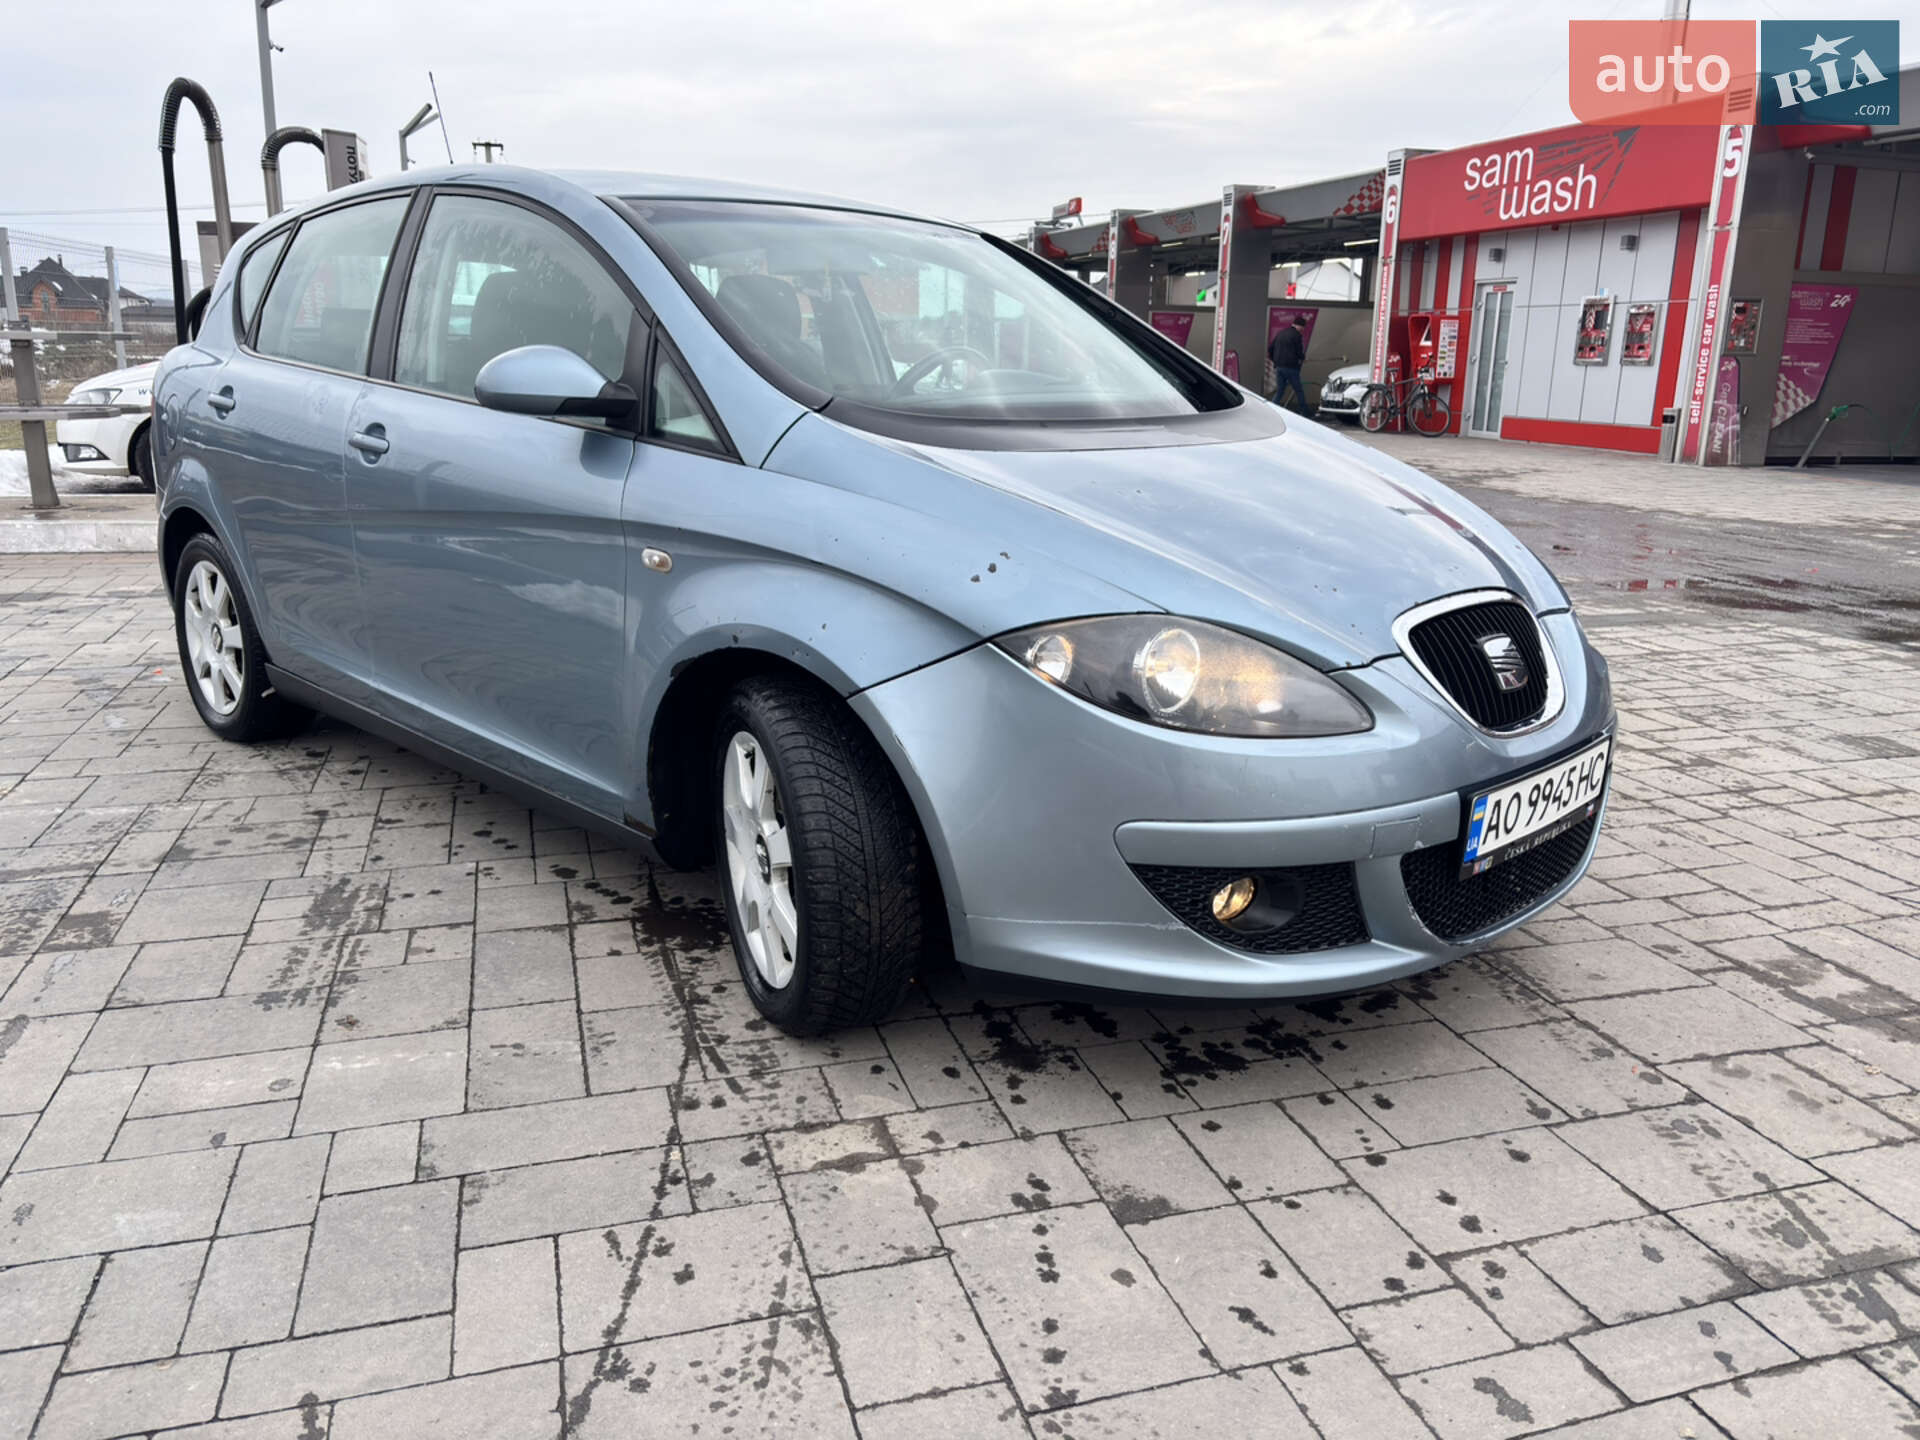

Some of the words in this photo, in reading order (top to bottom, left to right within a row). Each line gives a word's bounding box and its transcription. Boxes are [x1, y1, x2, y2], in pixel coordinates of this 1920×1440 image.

[1464, 147, 1534, 191] sam
[1723, 137, 1744, 178] 5
[1385, 195, 1397, 225] 6
[1499, 163, 1597, 221] wash
[1706, 284, 1720, 321] wash
[1702, 322, 1714, 345] car
[1689, 348, 1710, 425] self-service
[1482, 791, 1522, 846] AO
[1524, 765, 1577, 829] 9945
[1575, 751, 1605, 801] HC
[1466, 835, 1479, 852] UA
